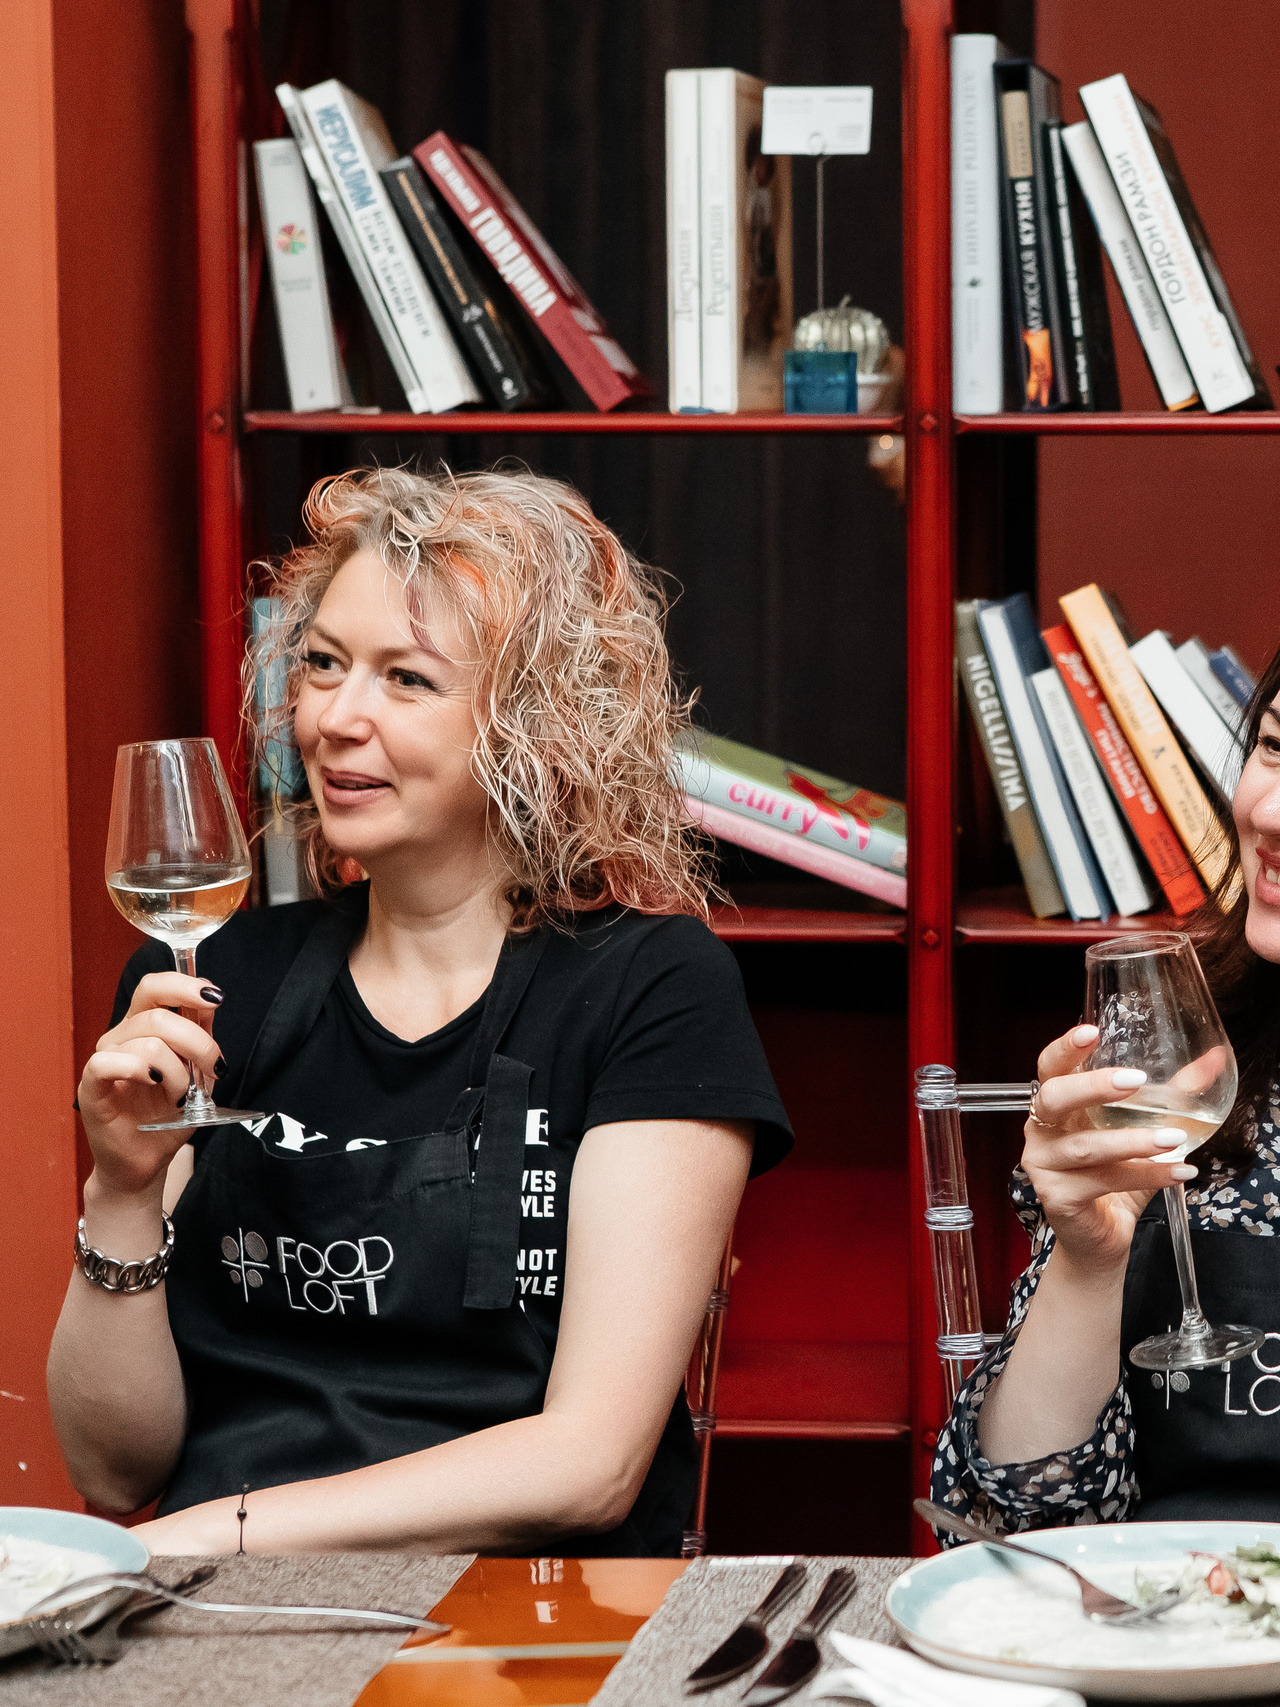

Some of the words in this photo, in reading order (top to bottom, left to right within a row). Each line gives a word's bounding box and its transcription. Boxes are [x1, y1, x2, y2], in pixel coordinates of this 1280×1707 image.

[1014, 180, 1036, 246] КУХНЯ
[1115, 151, 1151, 222] РАМЗИ
[469, 206, 557, 317] ГОВЯДИНА
[1143, 224, 1187, 306] ГОРДОН
[728, 782, 818, 836] curry
[520, 1196, 555, 1217] YLE
[276, 1236, 394, 1279] FOOD
[284, 1274, 386, 1316] LOFT
